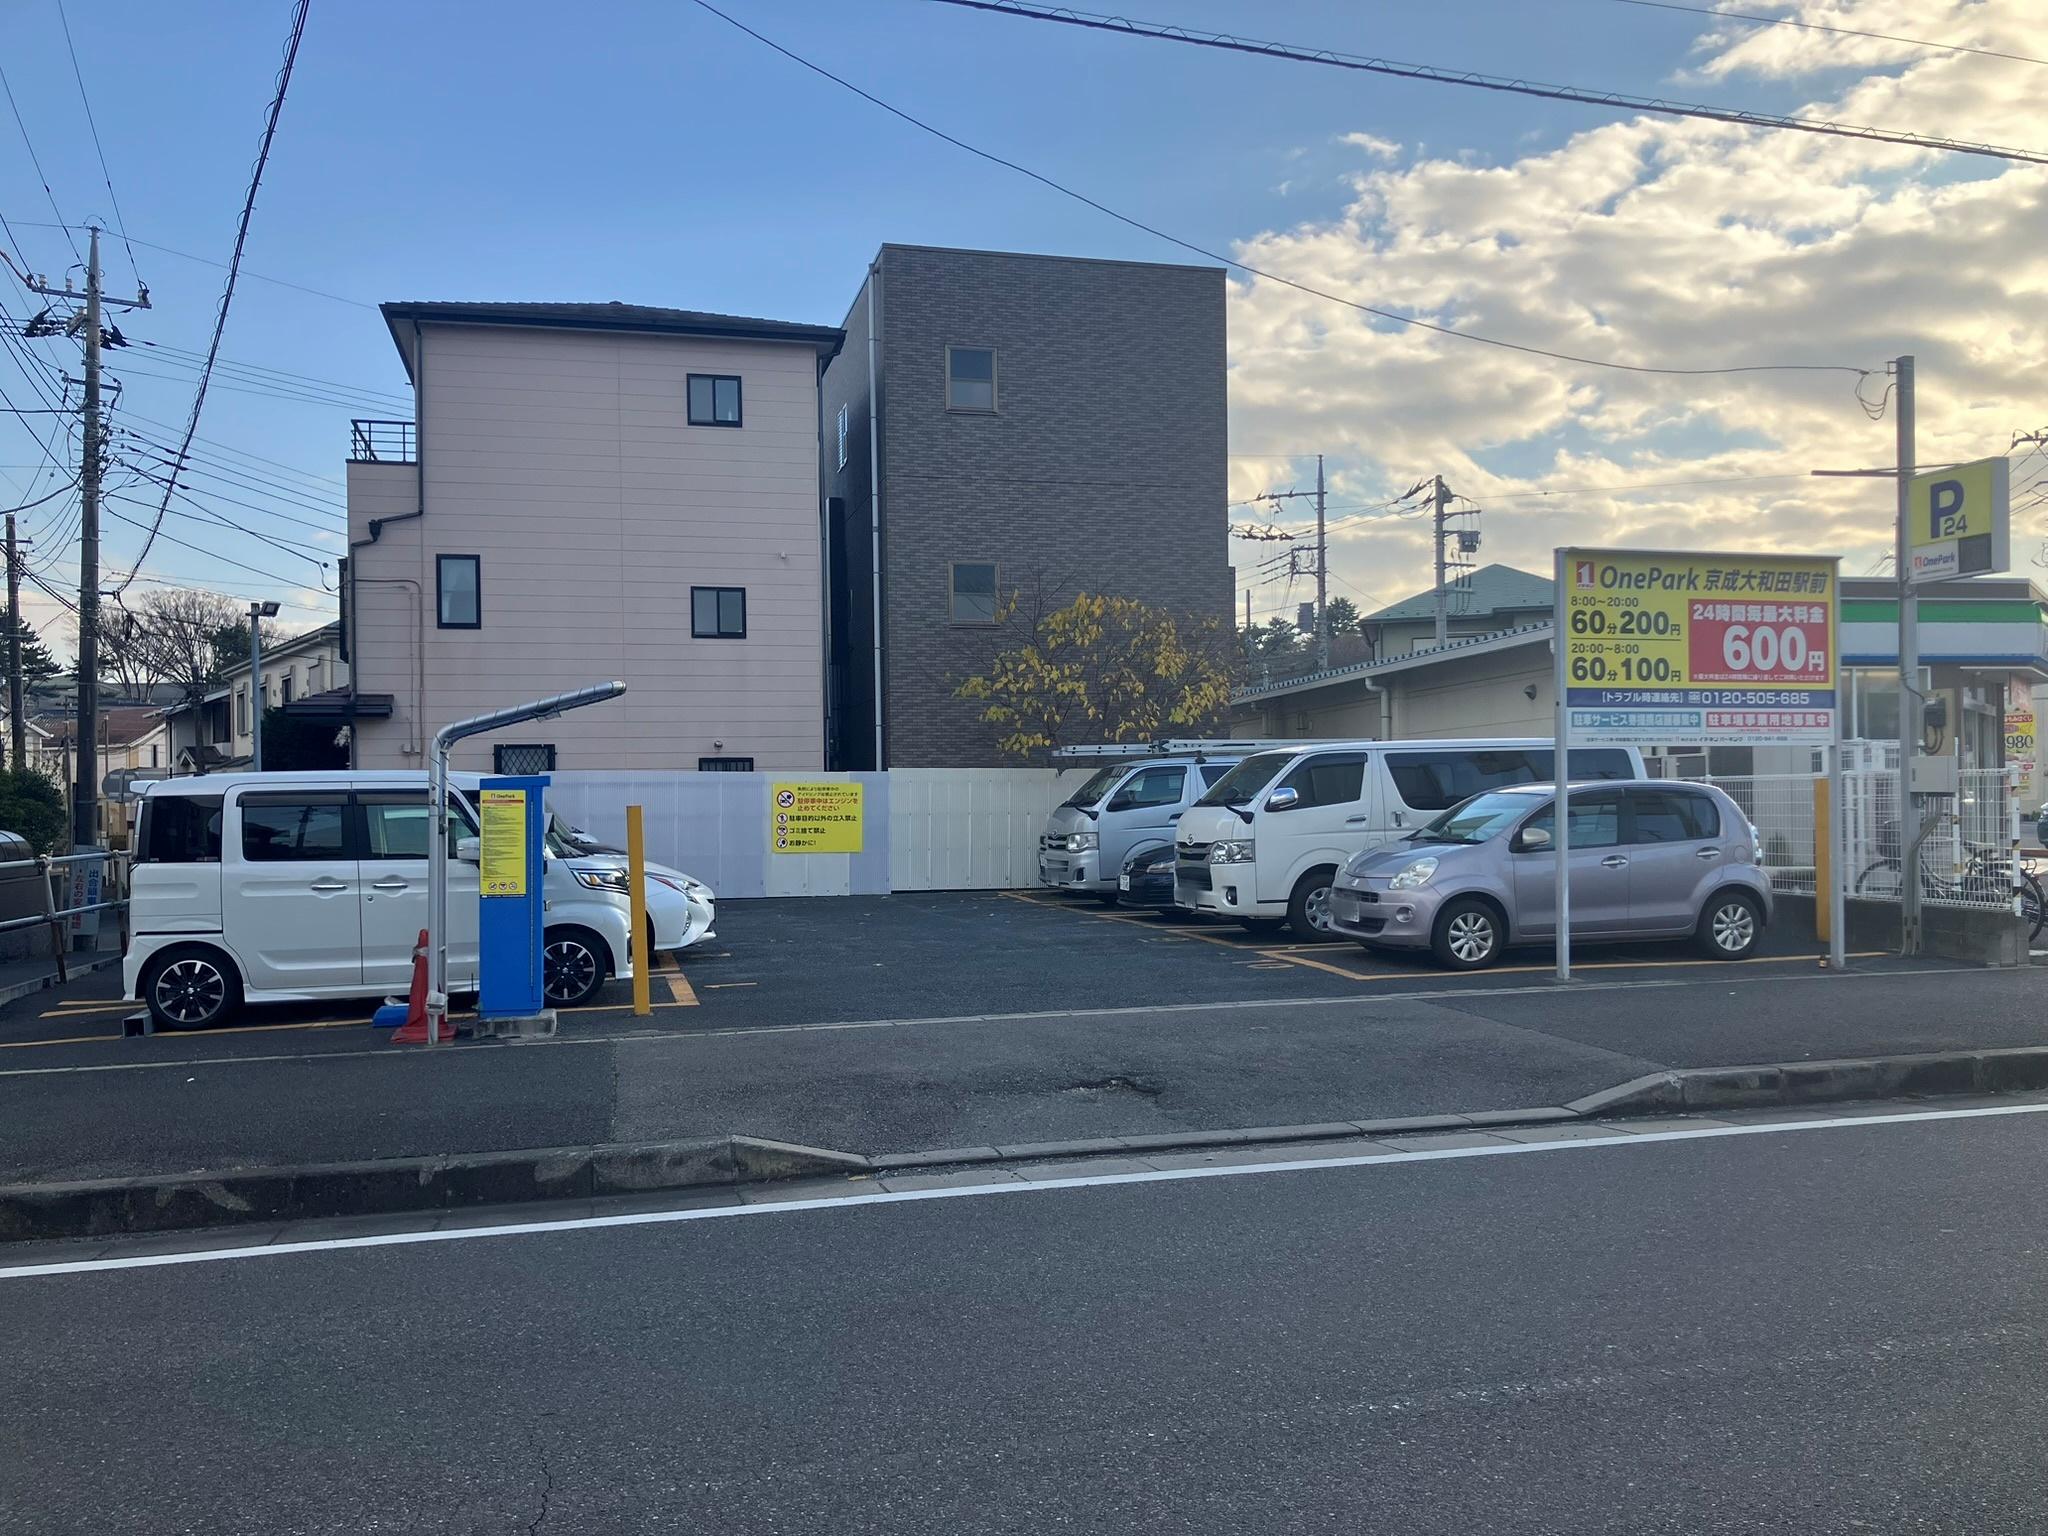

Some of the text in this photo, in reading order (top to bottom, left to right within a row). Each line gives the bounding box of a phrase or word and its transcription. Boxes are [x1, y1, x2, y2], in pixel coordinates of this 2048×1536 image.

[1930, 479, 1965, 539] P
[1943, 514, 1968, 536] 24
[1600, 565, 1700, 591] OnePark
[1703, 568, 1829, 594] 京成大和田駅前
[1692, 604, 1825, 624] 24時間毎最大料金
[1723, 624, 1825, 672] 600円
[1702, 692, 1810, 705] 0120-505-685
